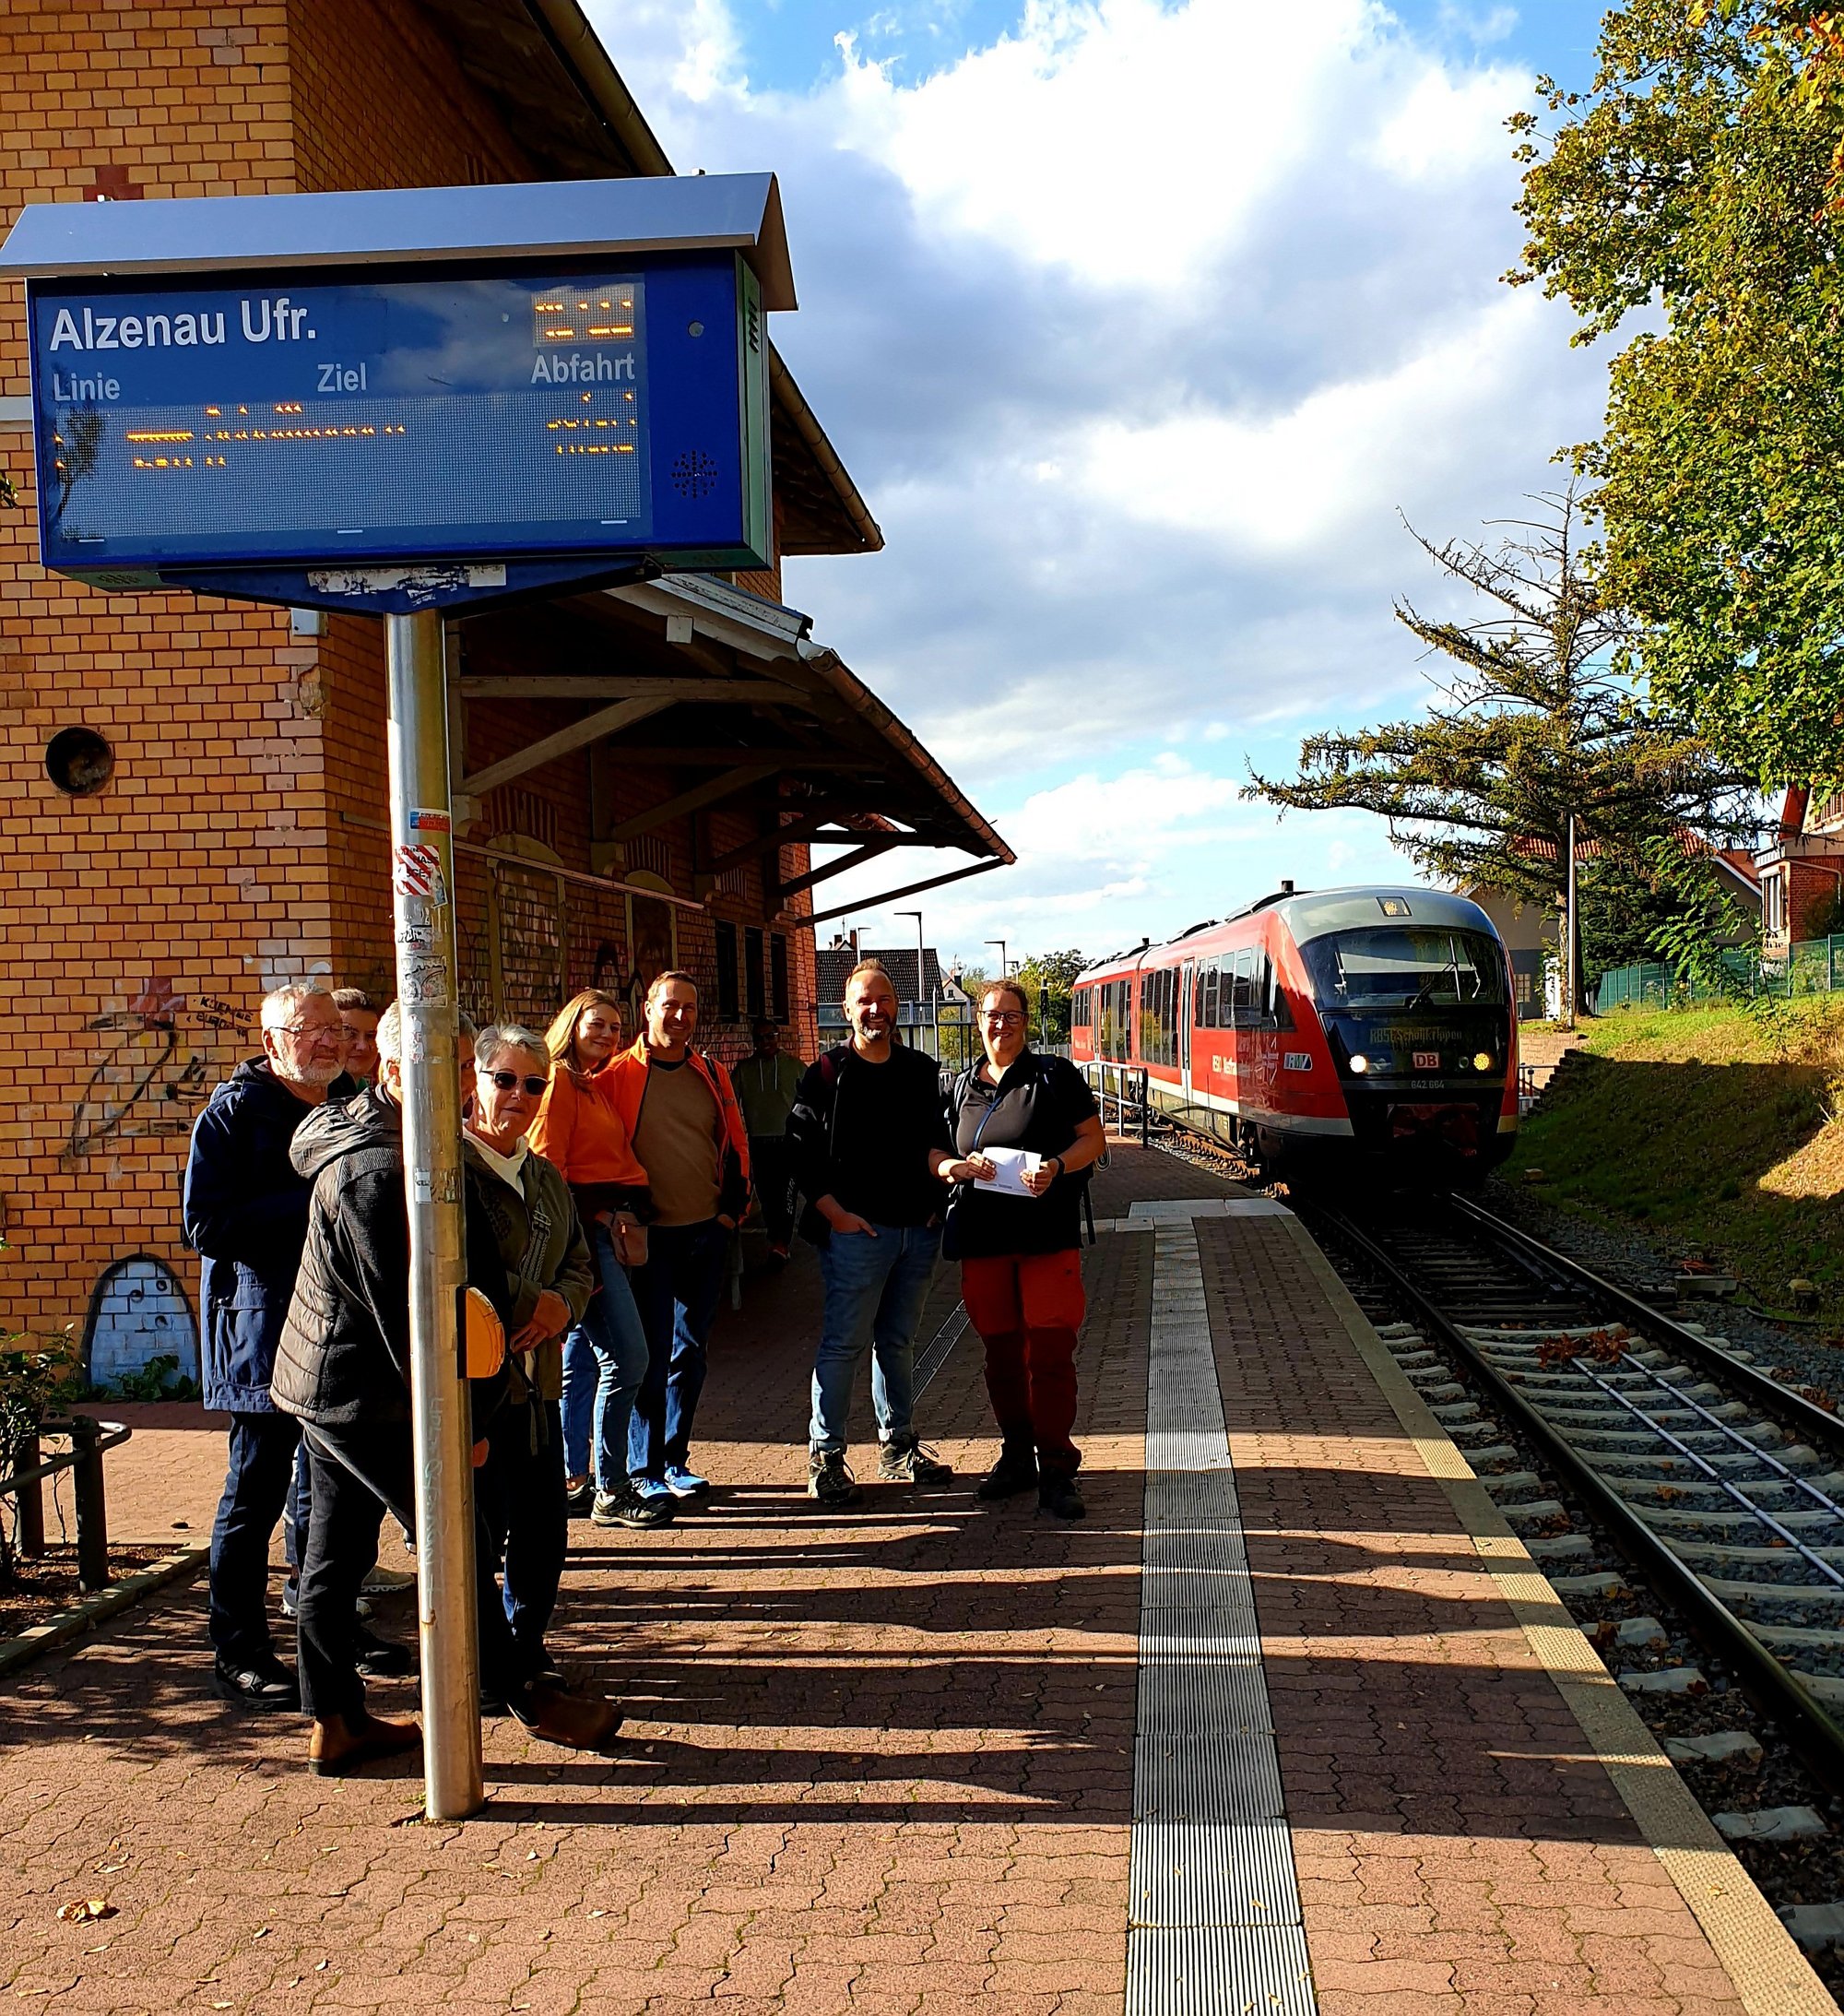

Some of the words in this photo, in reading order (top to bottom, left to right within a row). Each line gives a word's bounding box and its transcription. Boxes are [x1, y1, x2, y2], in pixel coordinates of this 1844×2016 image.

[50, 307, 225, 351] Alzenau
[241, 297, 317, 342] Ufr.
[317, 362, 368, 393] Ziel
[530, 351, 636, 385] Abfahrt
[53, 371, 121, 402] Linie
[1415, 1054, 1437, 1067] DB
